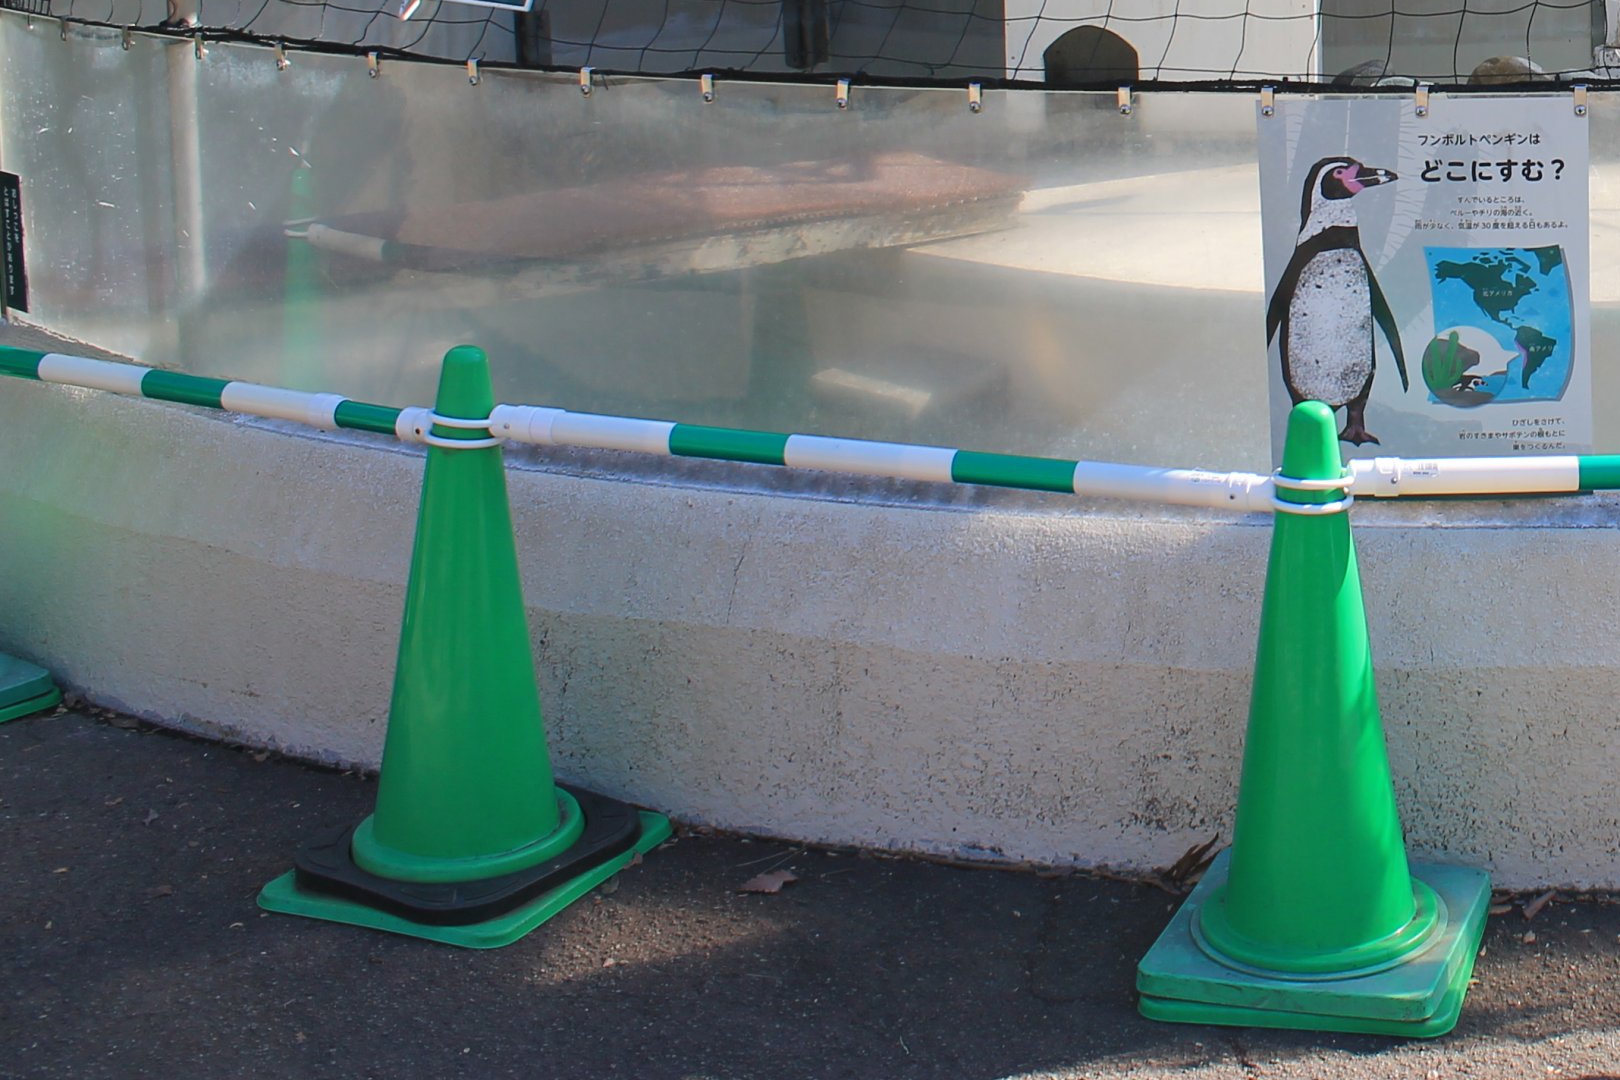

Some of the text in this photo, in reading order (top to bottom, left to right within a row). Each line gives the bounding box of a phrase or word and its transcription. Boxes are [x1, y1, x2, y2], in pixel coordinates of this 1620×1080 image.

[1418, 133, 1541, 146] フンボルトペンギンは
[1420, 158, 1565, 182] どこにすむ？
